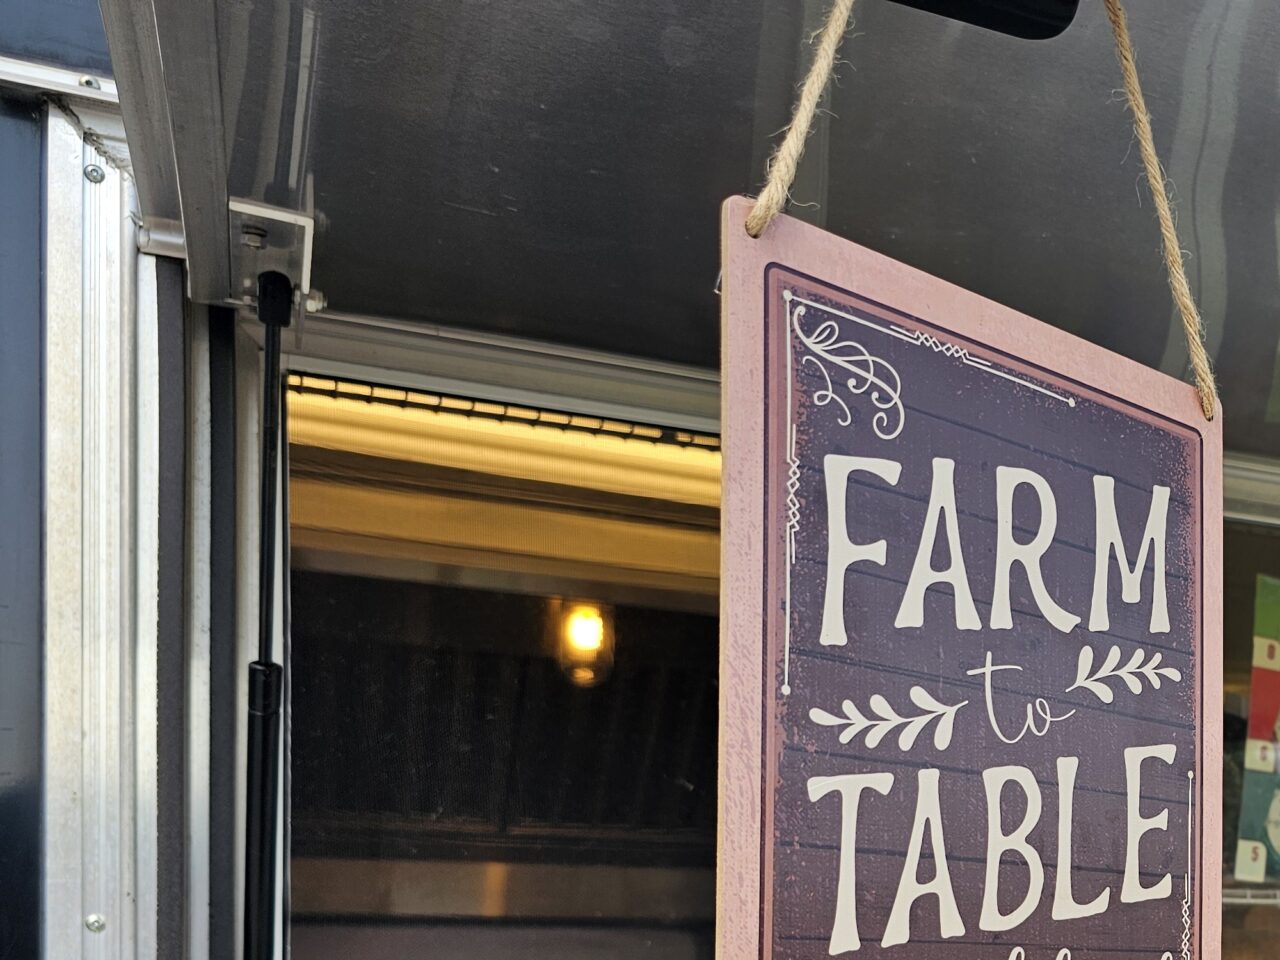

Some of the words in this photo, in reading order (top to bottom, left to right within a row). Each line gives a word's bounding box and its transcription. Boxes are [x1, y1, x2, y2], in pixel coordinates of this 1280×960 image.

[819, 453, 1171, 647] FARM
[966, 651, 1076, 744] to
[807, 743, 1178, 956] TABLE
